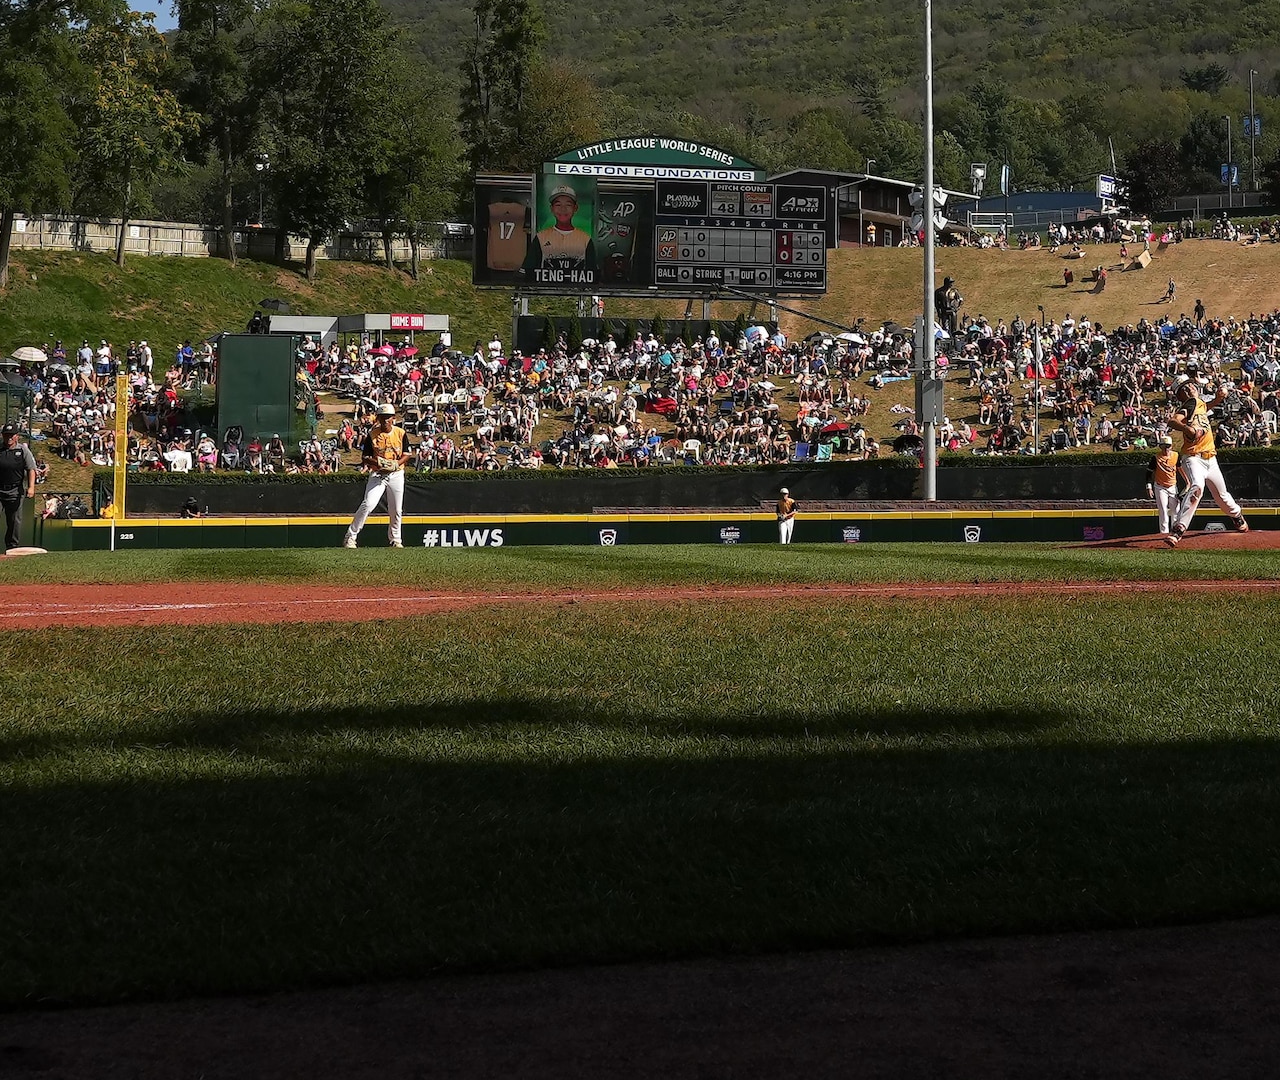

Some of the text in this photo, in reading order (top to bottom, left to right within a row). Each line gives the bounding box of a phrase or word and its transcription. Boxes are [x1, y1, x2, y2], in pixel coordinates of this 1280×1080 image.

[577, 142, 612, 160] LITTLE
[660, 139, 697, 153] WORLD
[699, 146, 734, 166] SERIES
[558, 164, 752, 180] EASTON FOUNDATIONS
[613, 202, 635, 217] AP
[718, 203, 735, 214] 48
[750, 204, 764, 215] 41
[499, 222, 516, 240] 17
[661, 230, 706, 242] AP 1 0
[782, 234, 788, 245] 1
[811, 236, 820, 246] 0
[660, 246, 706, 258] SE 0 0
[780, 251, 820, 262] 0 2 0
[559, 260, 570, 269] YU
[534, 270, 594, 283] TENG-HAO
[658, 268, 768, 282] BALL 0 STRIKE 1 OUT 0
[783, 271, 818, 279] 4:16 PM
[391, 316, 410, 327] HOME
[422, 528, 504, 547] #LLWS
